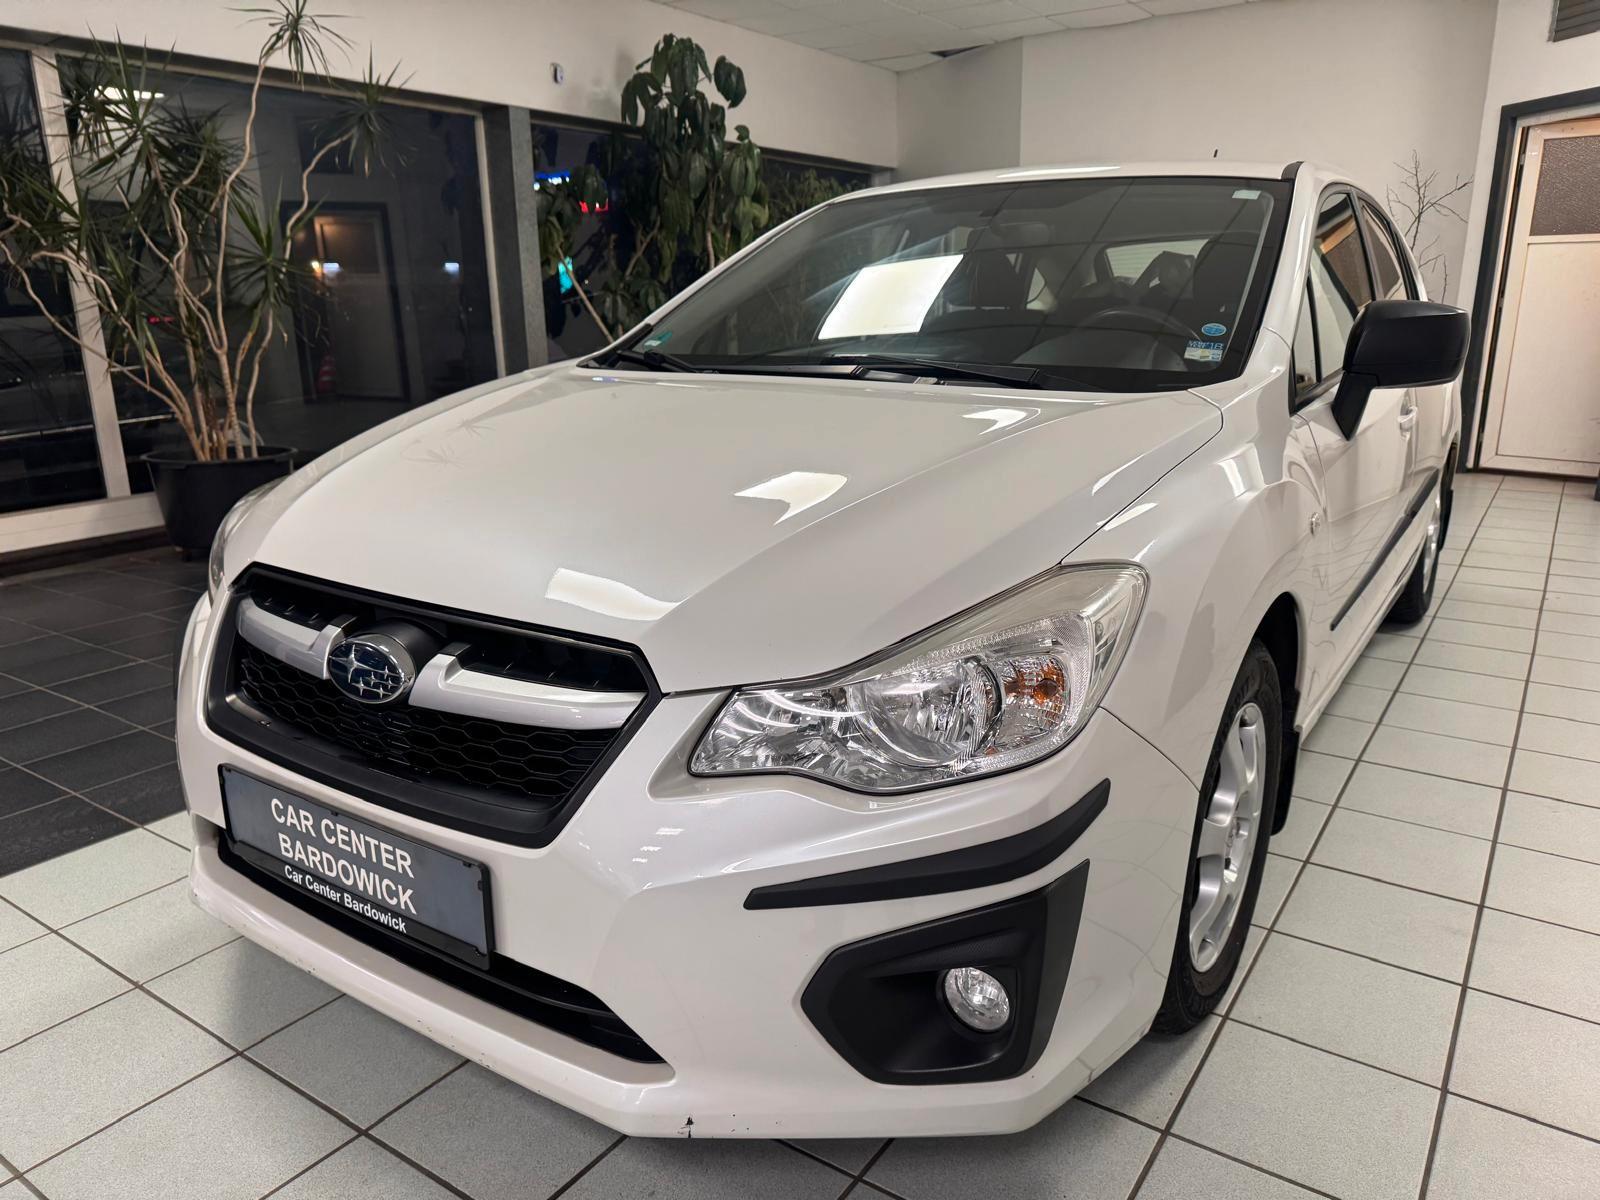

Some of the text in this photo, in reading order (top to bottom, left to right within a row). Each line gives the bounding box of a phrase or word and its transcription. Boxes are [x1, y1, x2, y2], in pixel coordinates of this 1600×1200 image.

[271, 798, 415, 878] CAR CENTER
[279, 833, 417, 914] BARDOWICK
[284, 865, 407, 933] Car Center Bardowick
